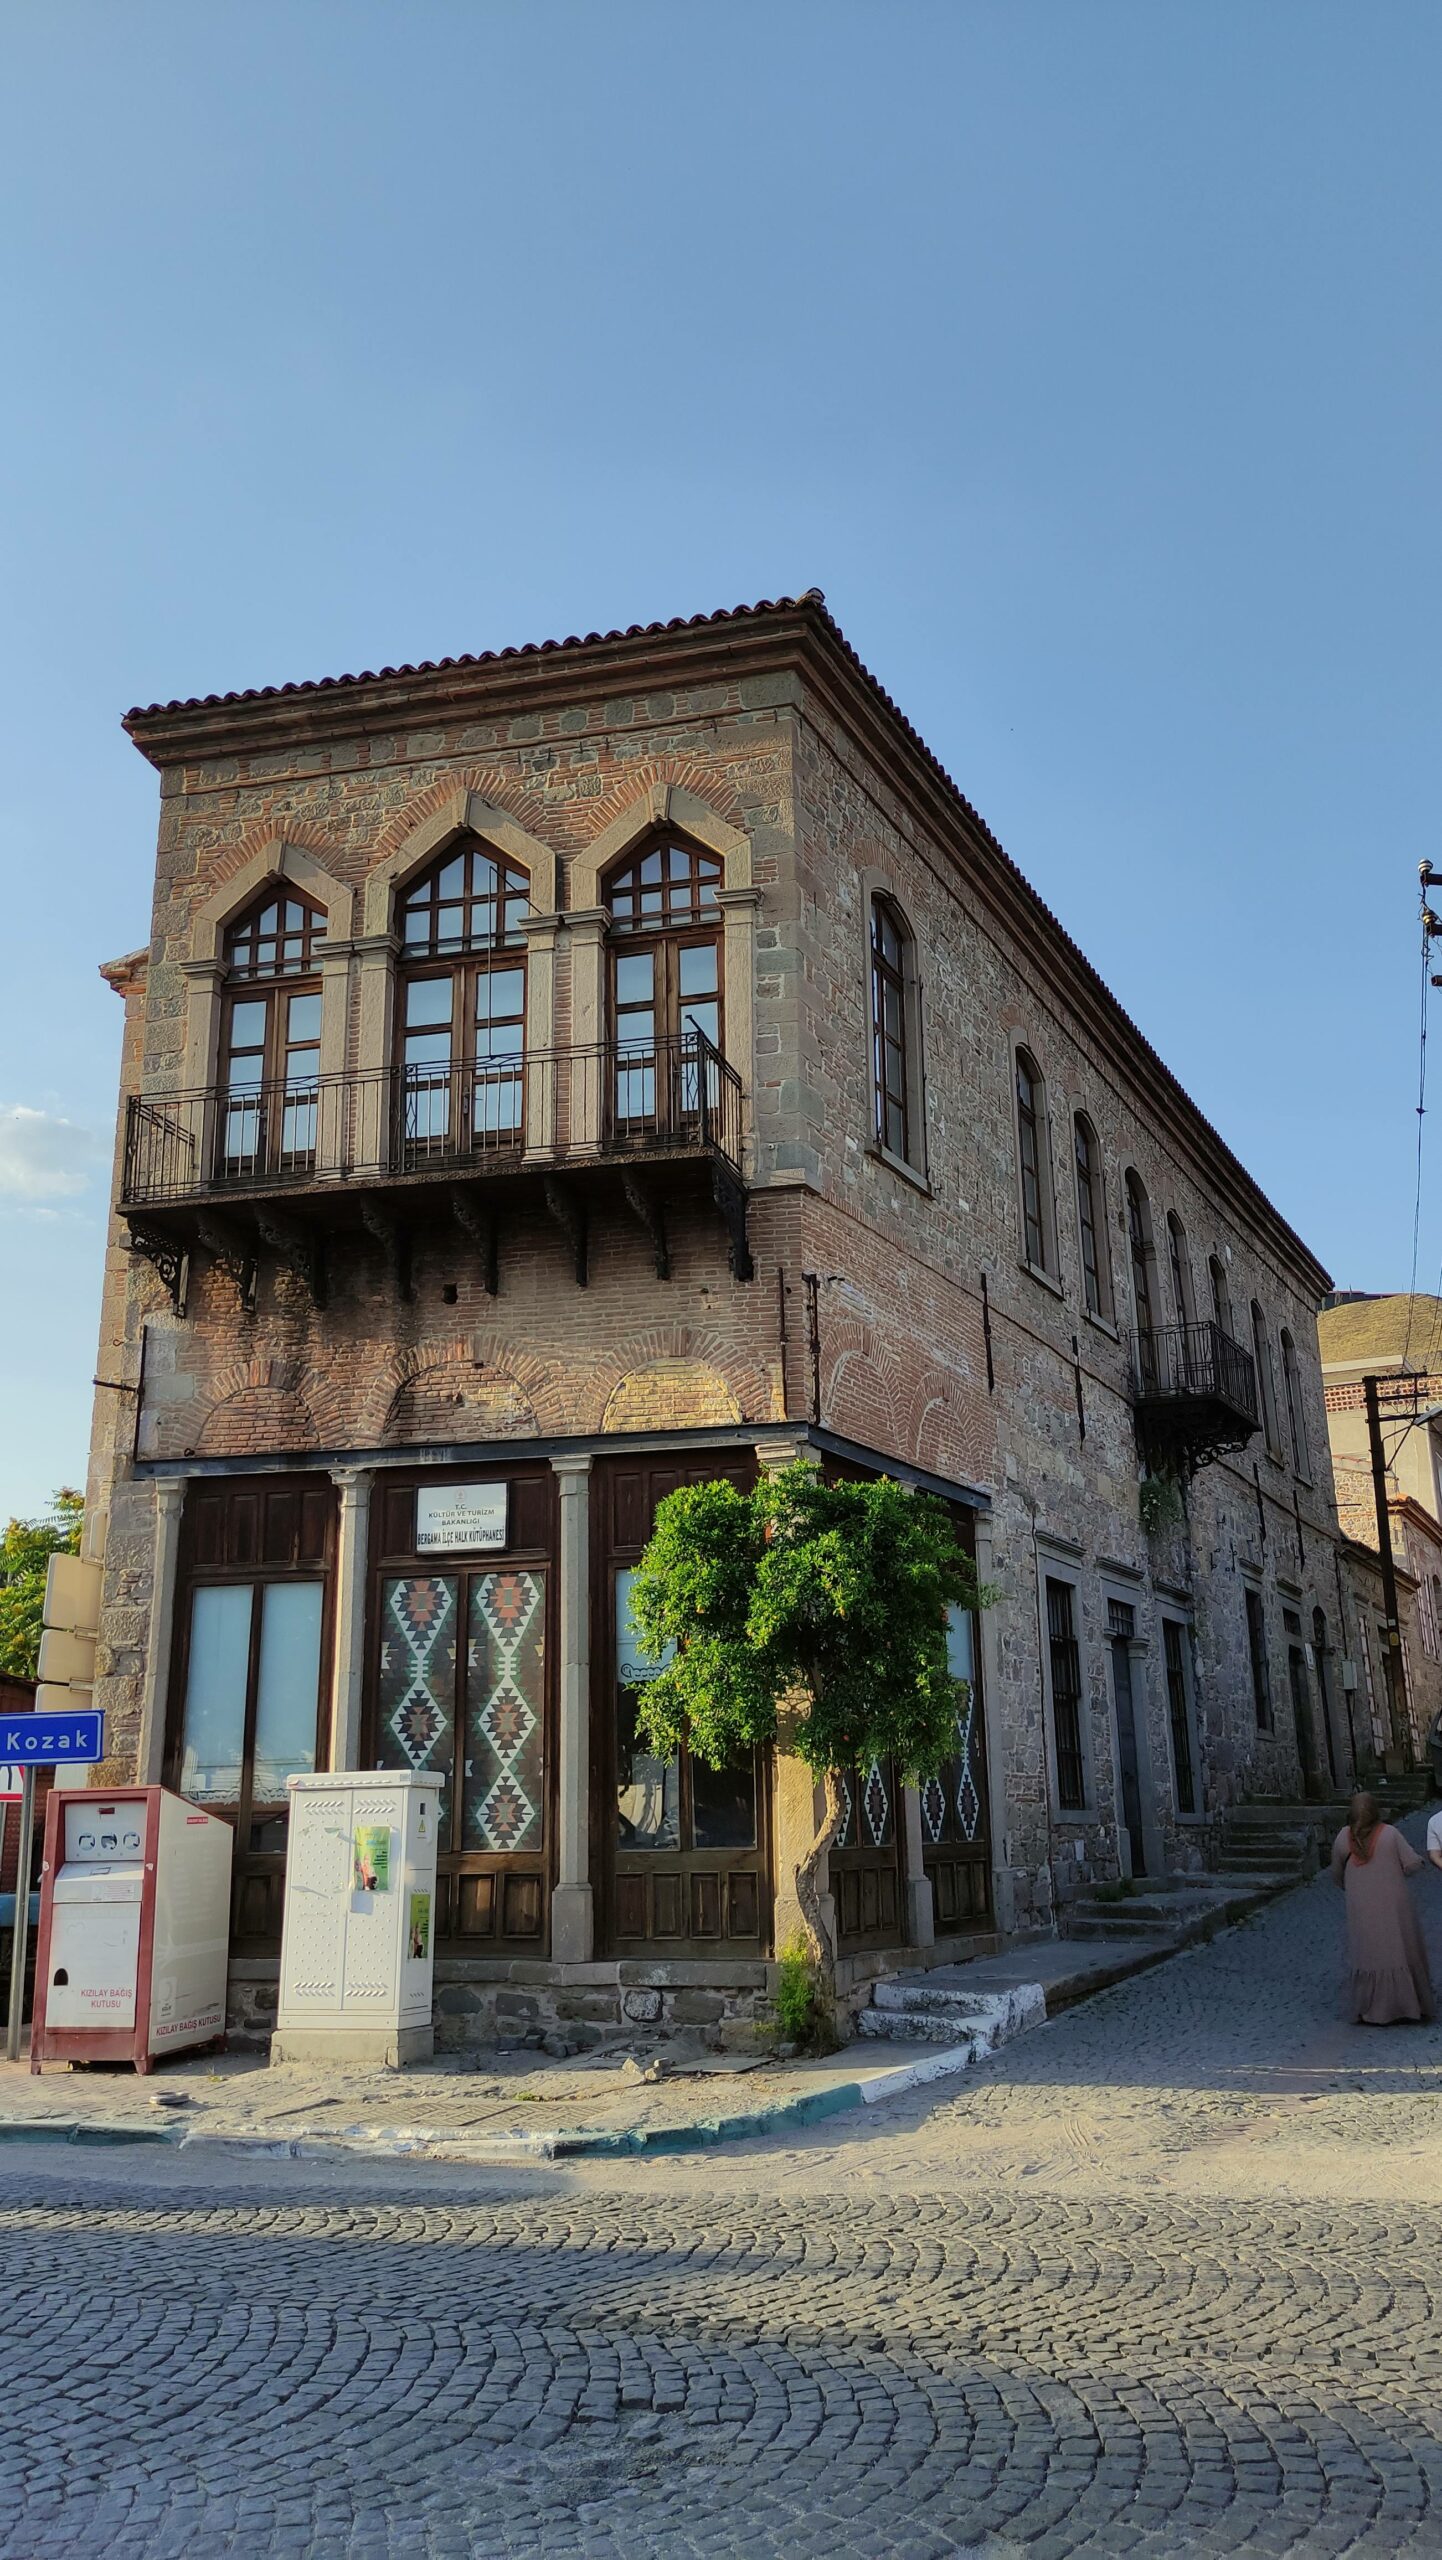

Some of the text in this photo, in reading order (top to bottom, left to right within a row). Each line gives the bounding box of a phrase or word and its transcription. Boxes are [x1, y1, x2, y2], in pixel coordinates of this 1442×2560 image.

[441, 1518, 480, 1526] BAKANLIĞI
[417, 1526, 505, 1546] BERGAMA İLÇE HALK KÜTÜPHANESİ
[7, 1729, 89, 1751] Kozak
[80, 1987, 133, 2000] KIZILAY BAĞIŞ
[91, 2000, 121, 2008] KUTUSU
[156, 2023, 178, 2036] KIZILAY
[198, 2013, 222, 2027] KUTUSU
